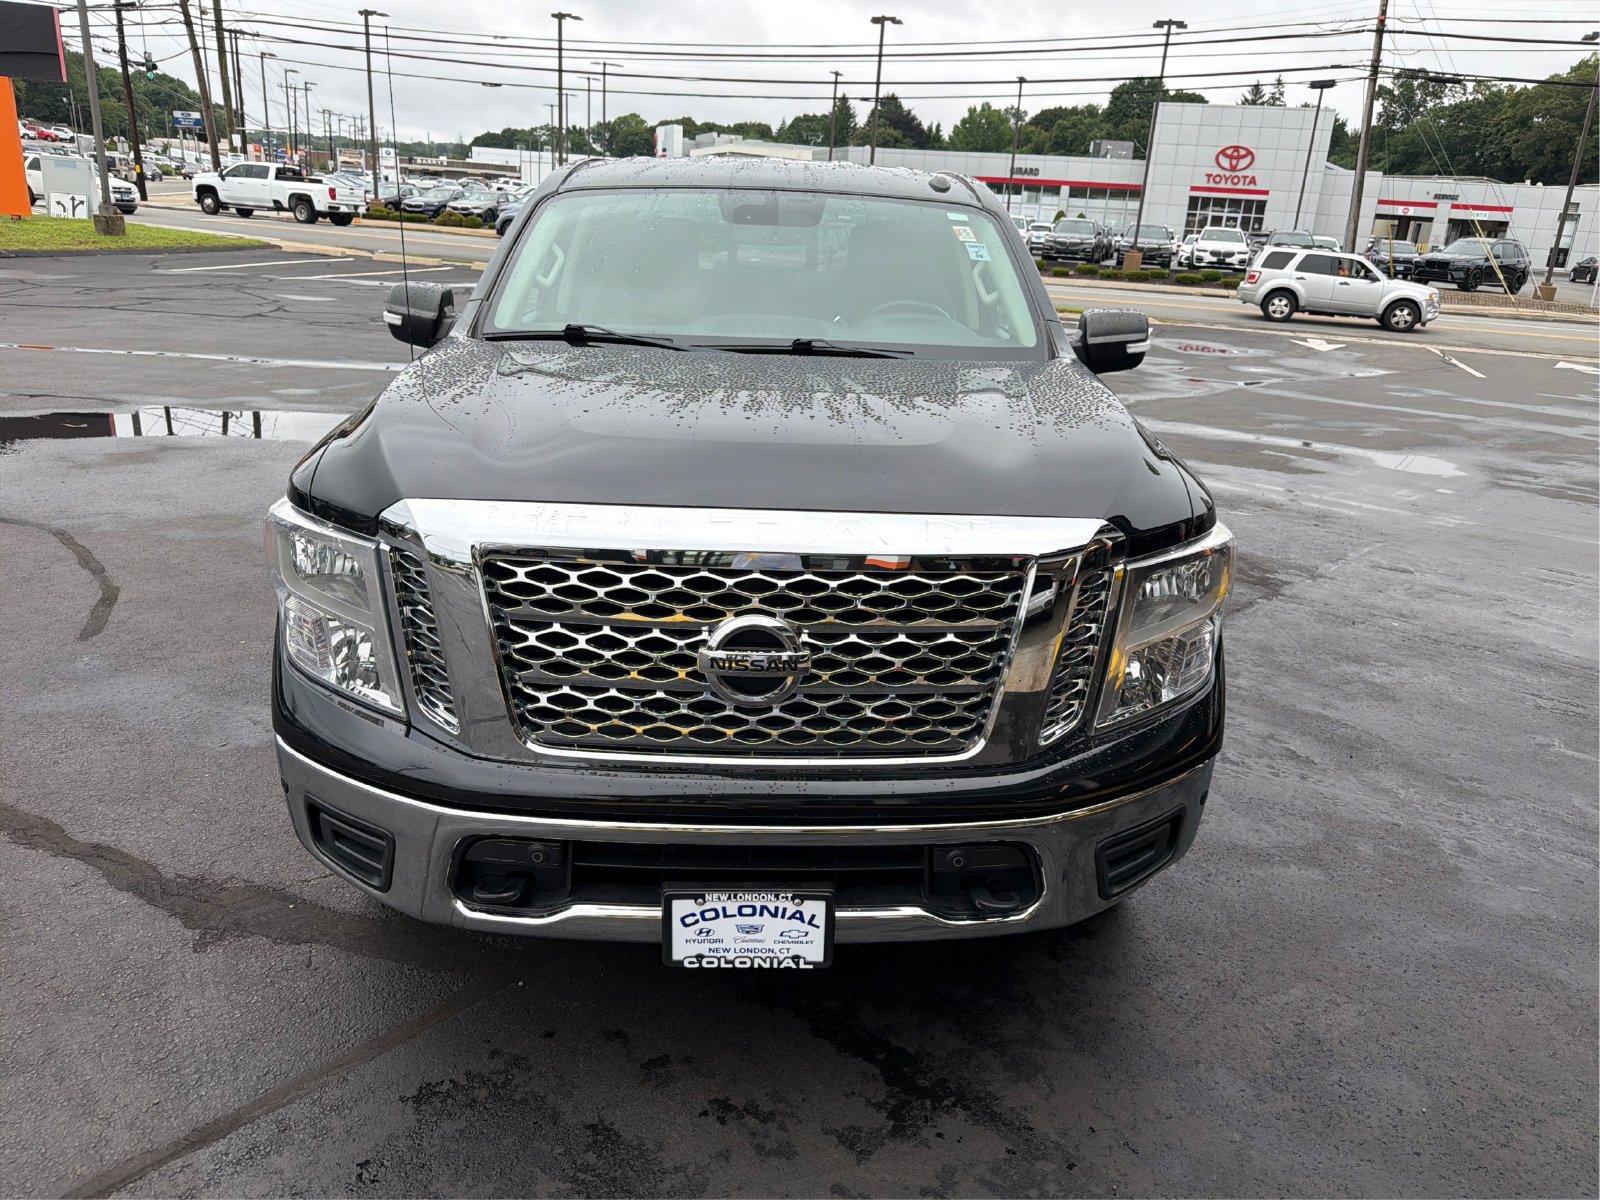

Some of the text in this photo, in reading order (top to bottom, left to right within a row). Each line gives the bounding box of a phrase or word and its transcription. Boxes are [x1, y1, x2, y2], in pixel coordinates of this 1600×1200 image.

[1205, 173, 1257, 186] TOYOTA
[710, 656, 798, 672] NISSAN
[705, 893, 793, 903] NEW LONDON, CT
[680, 904, 821, 929] COLONIAL
[733, 936, 766, 944] Cadillac
[733, 947, 777, 955] LONDON,
[683, 956, 814, 969] COLONIAL
